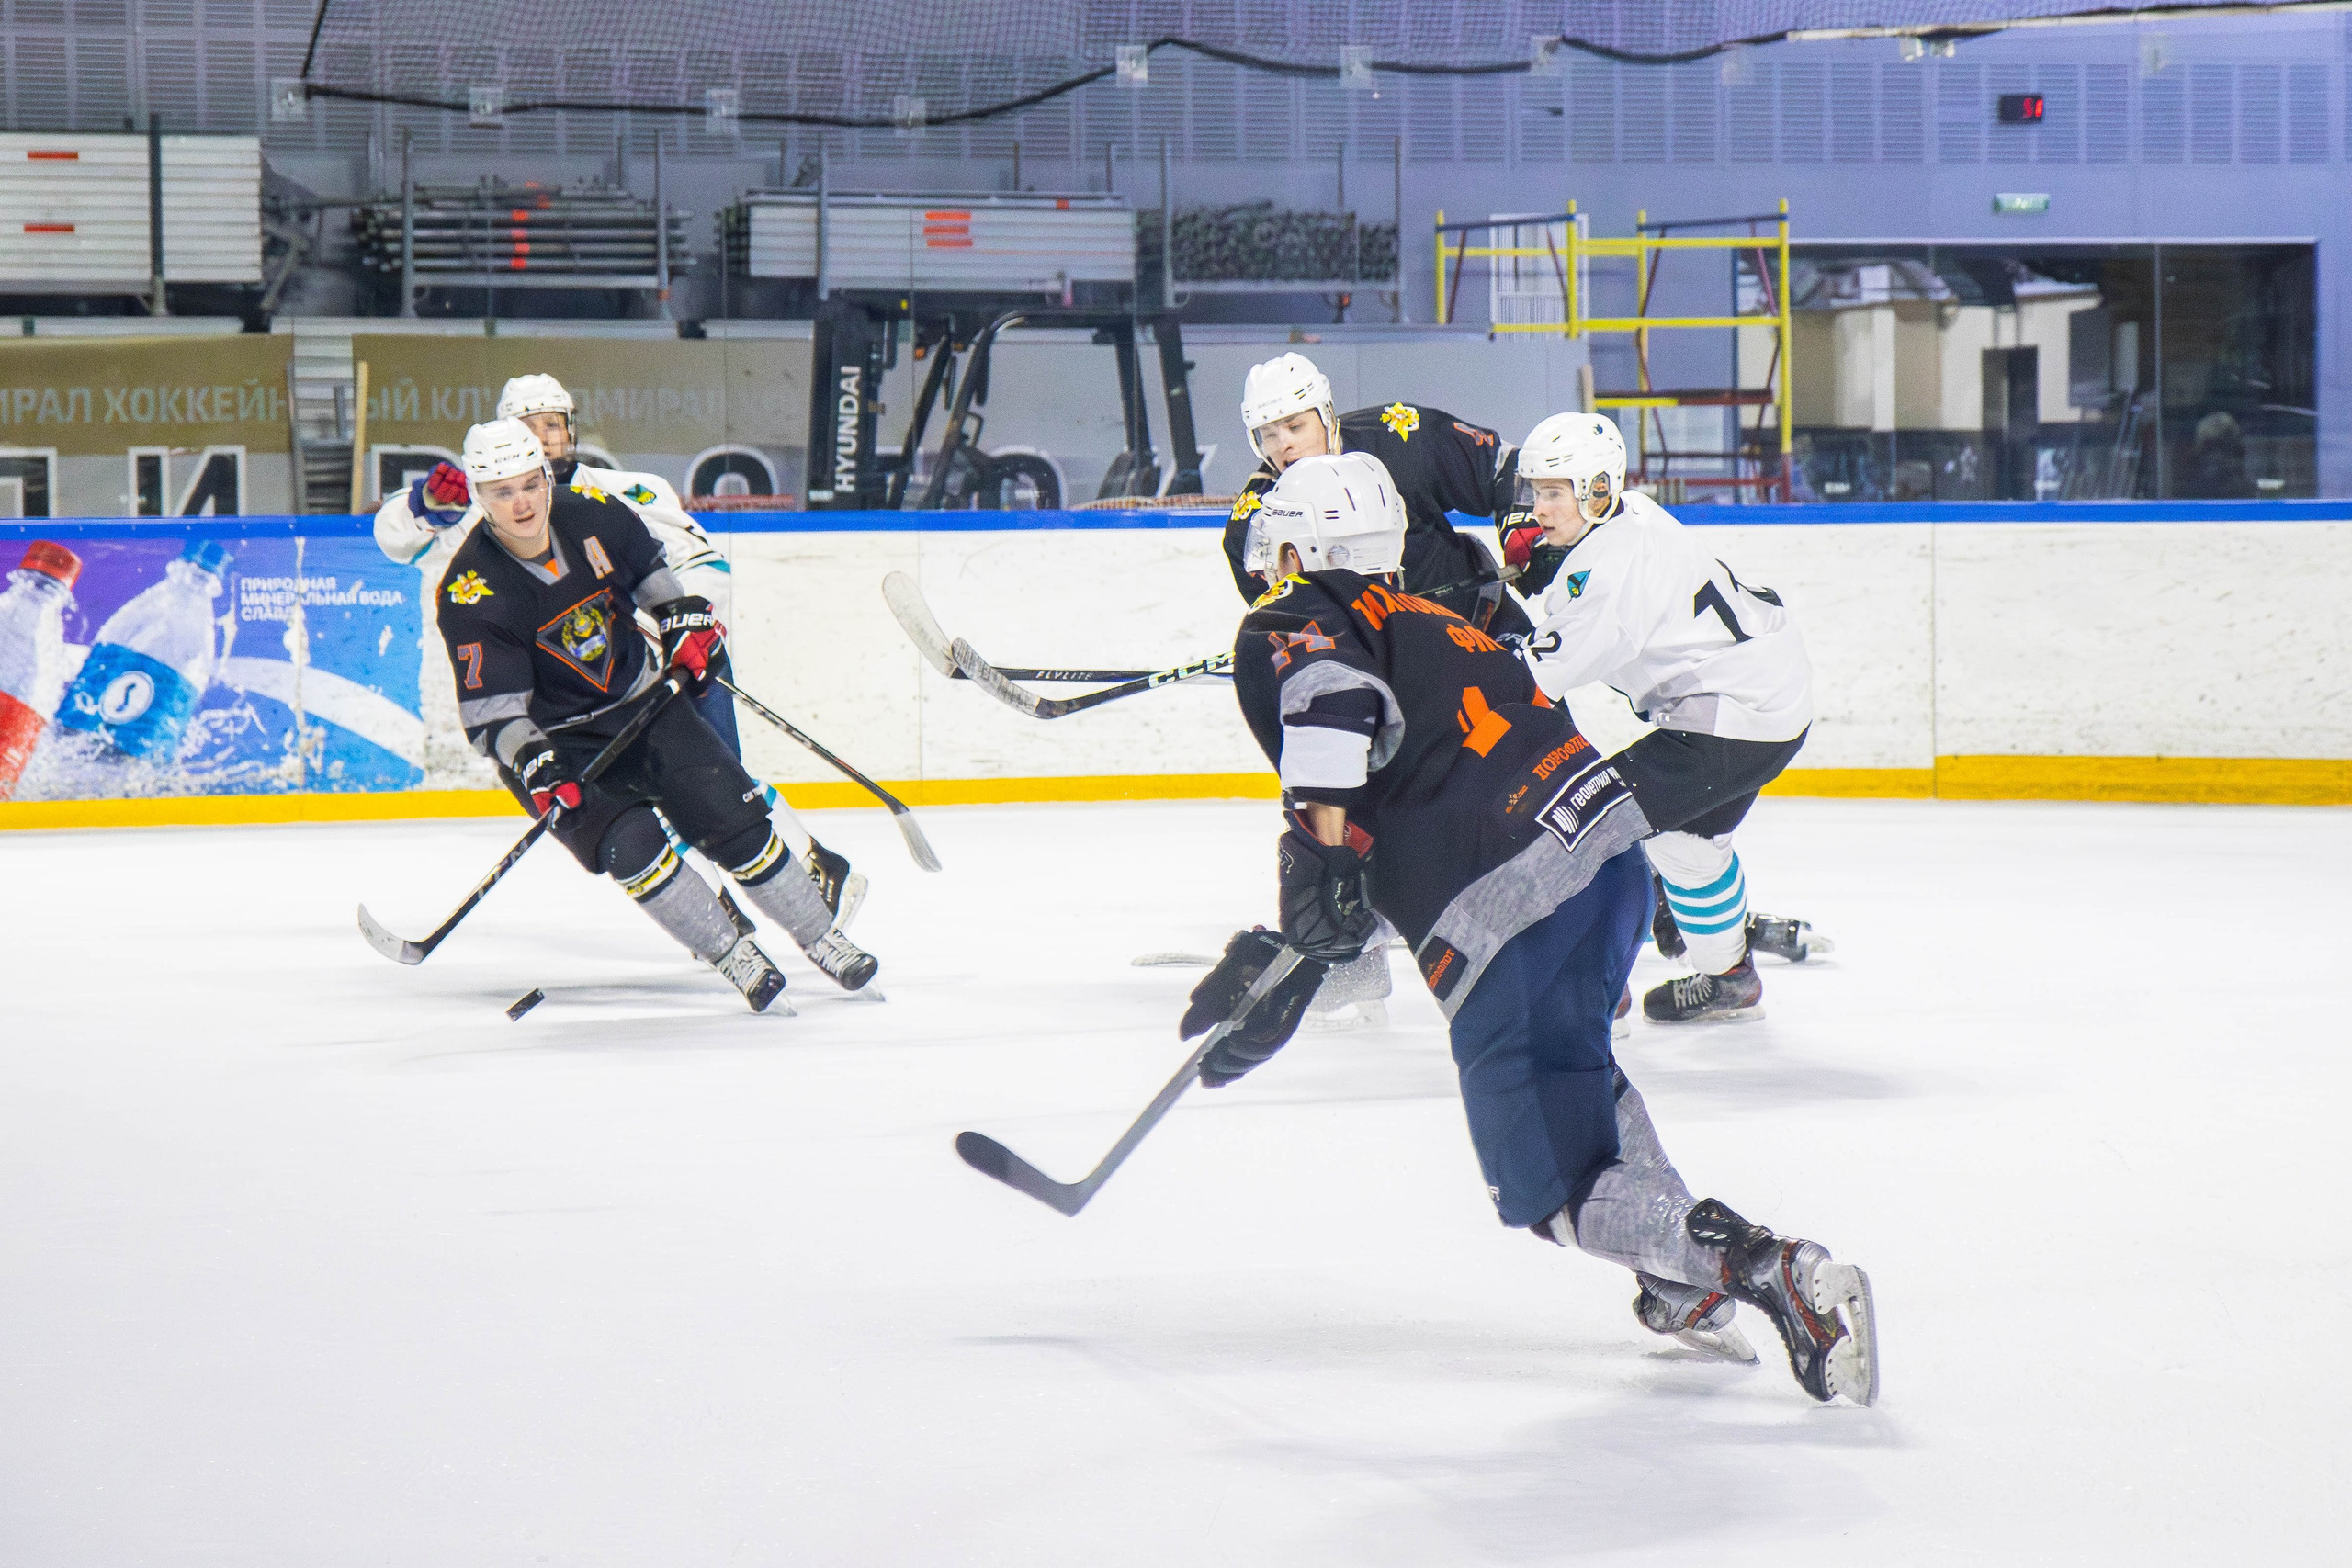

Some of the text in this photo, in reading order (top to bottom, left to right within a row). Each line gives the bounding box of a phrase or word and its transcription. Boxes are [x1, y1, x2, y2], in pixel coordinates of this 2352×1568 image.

[834, 366, 861, 492] HYUNDAI
[1272, 508, 1304, 518] BAUER
[358, 590, 404, 607] ВОДА
[661, 613, 714, 634] AUER
[457, 642, 484, 690] 7
